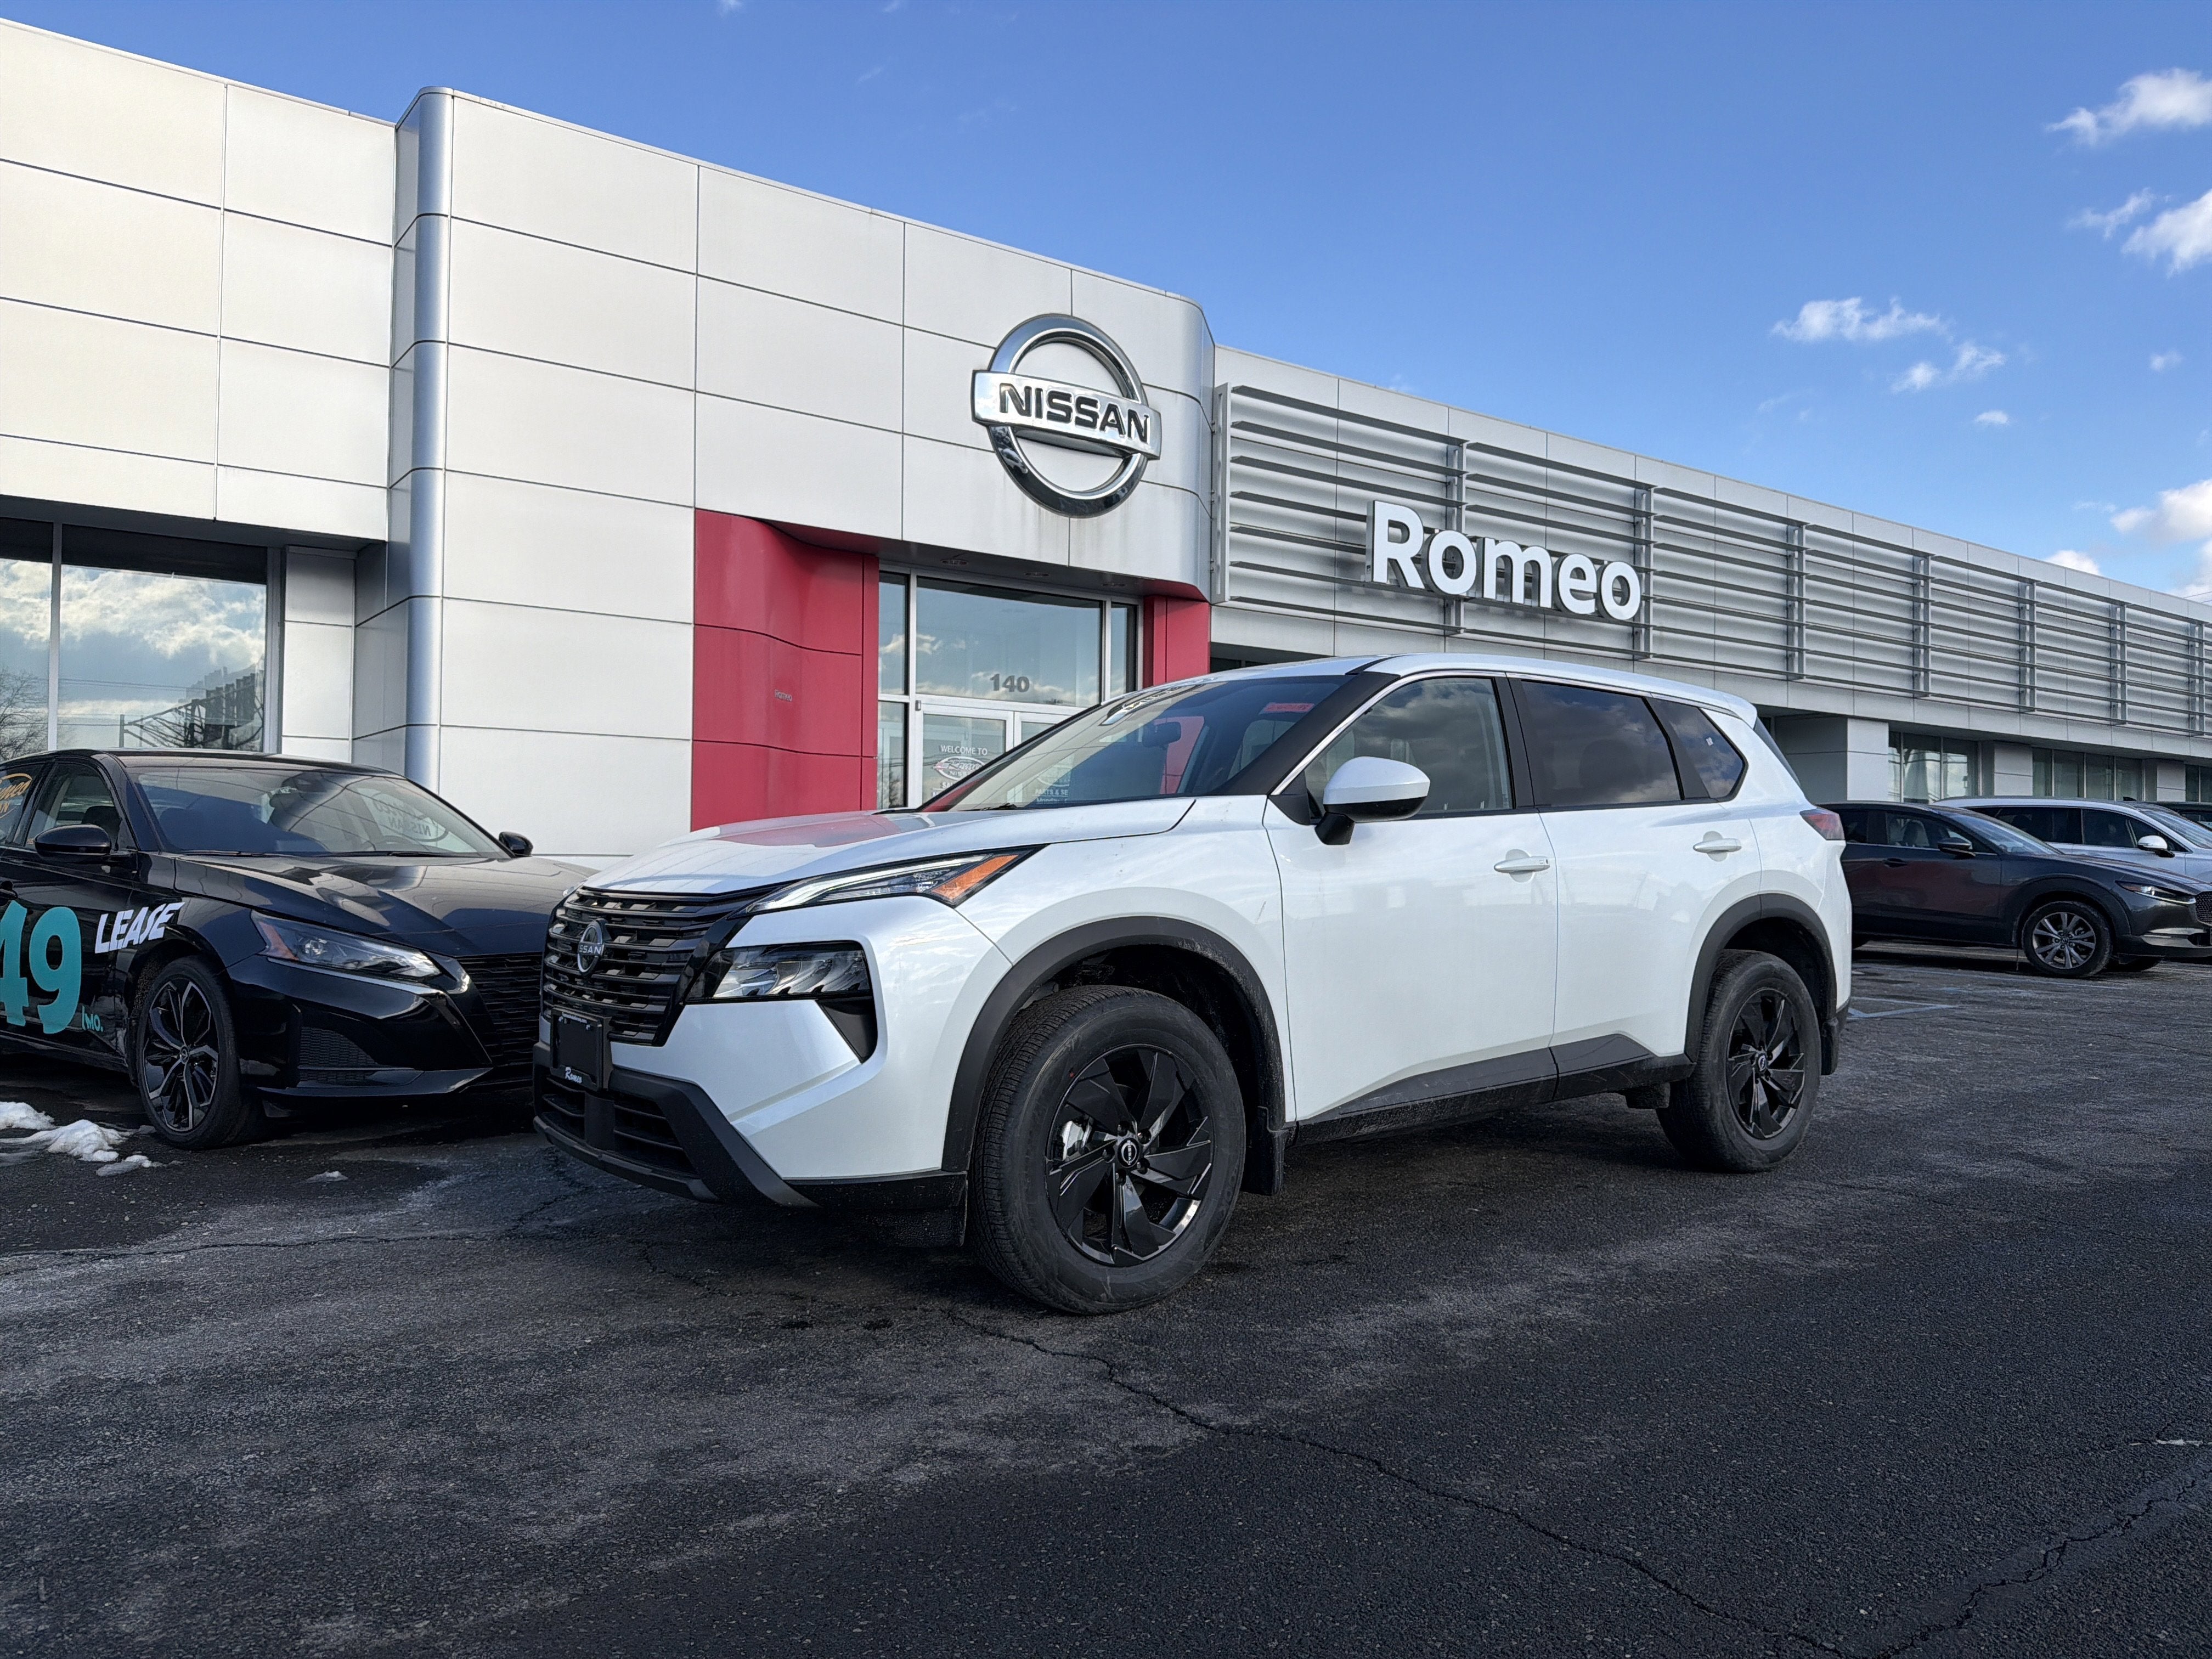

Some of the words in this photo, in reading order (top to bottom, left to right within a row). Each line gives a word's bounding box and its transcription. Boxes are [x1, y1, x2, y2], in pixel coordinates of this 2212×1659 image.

[999, 382, 1149, 444] NISSAN
[1370, 500, 1641, 620] Romeo
[990, 673, 1030, 693] 140
[940, 745, 976, 755] WELCOME
[94, 901, 185, 954] LEASE
